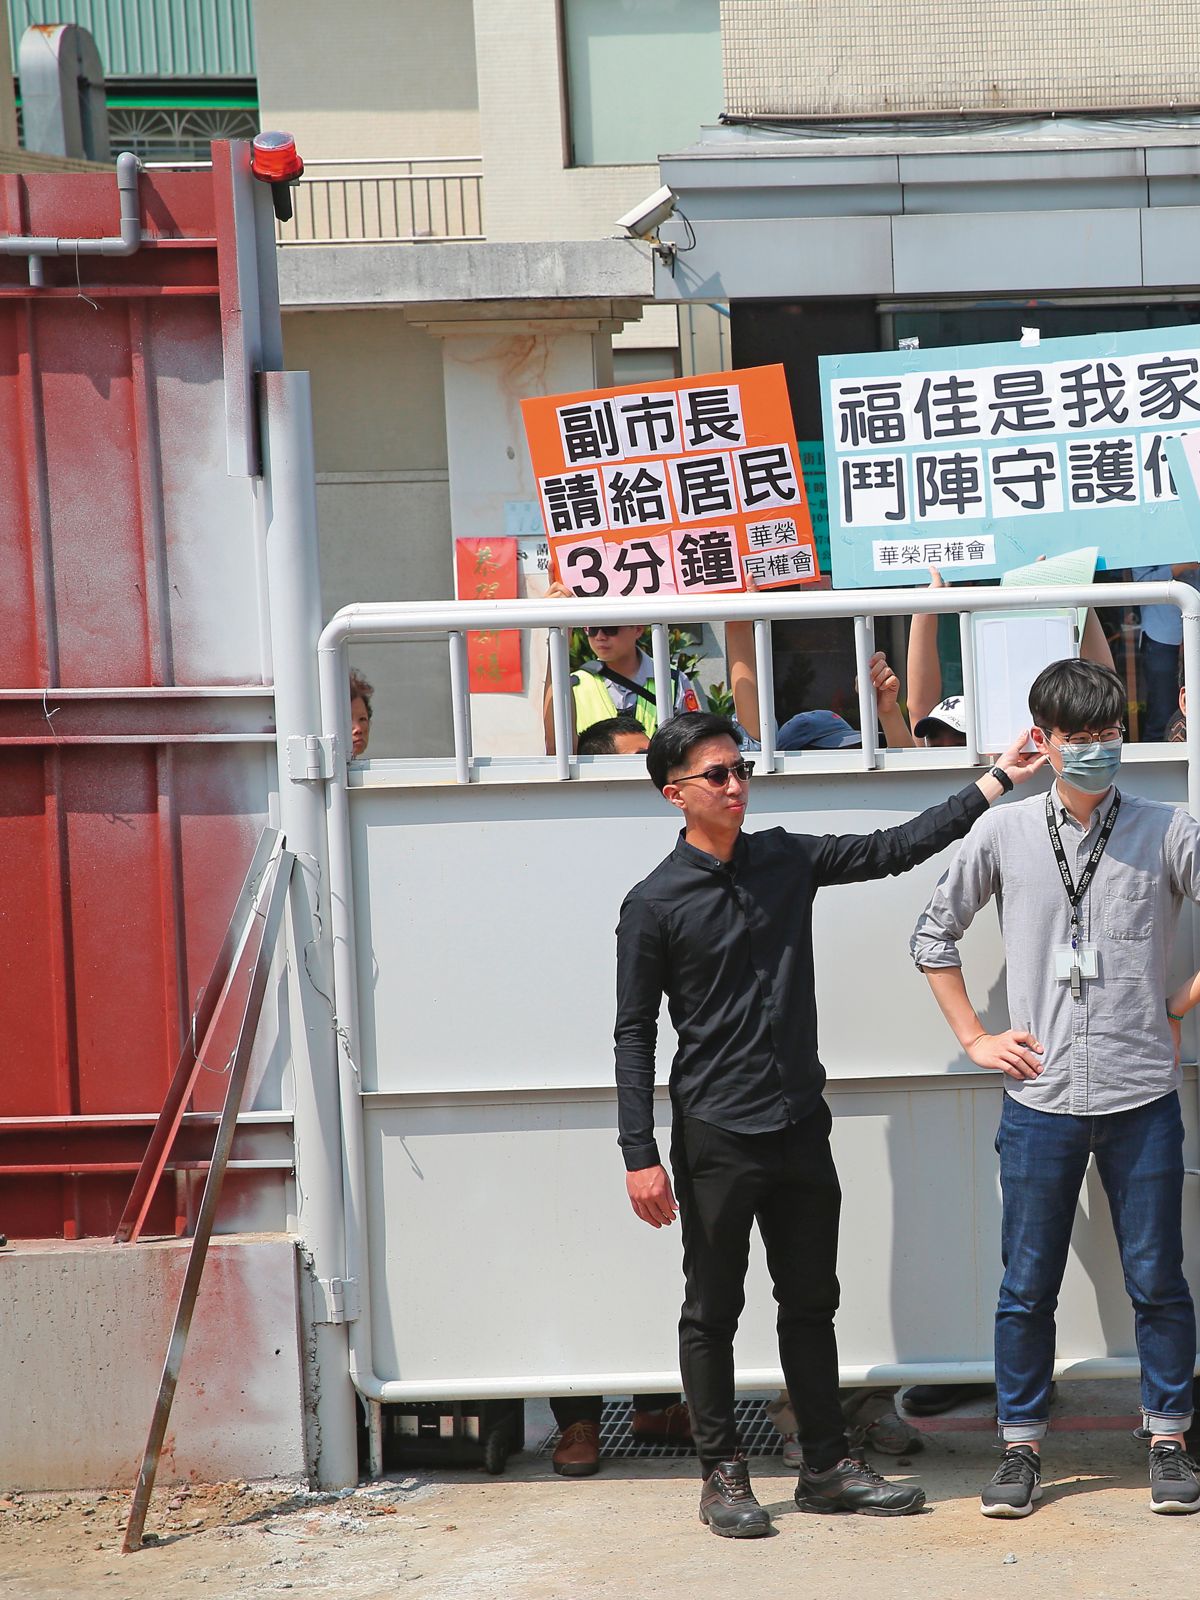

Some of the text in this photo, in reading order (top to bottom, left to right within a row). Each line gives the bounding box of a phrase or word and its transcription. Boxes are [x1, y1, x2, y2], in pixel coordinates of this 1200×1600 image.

[560, 388, 741, 463] 副市長
[544, 449, 796, 532] 請給居民
[750, 521, 797, 547] 華榮
[879, 540, 986, 565] 華榮居權會
[567, 531, 737, 597] 3分鐘
[745, 551, 813, 577] 居權會
